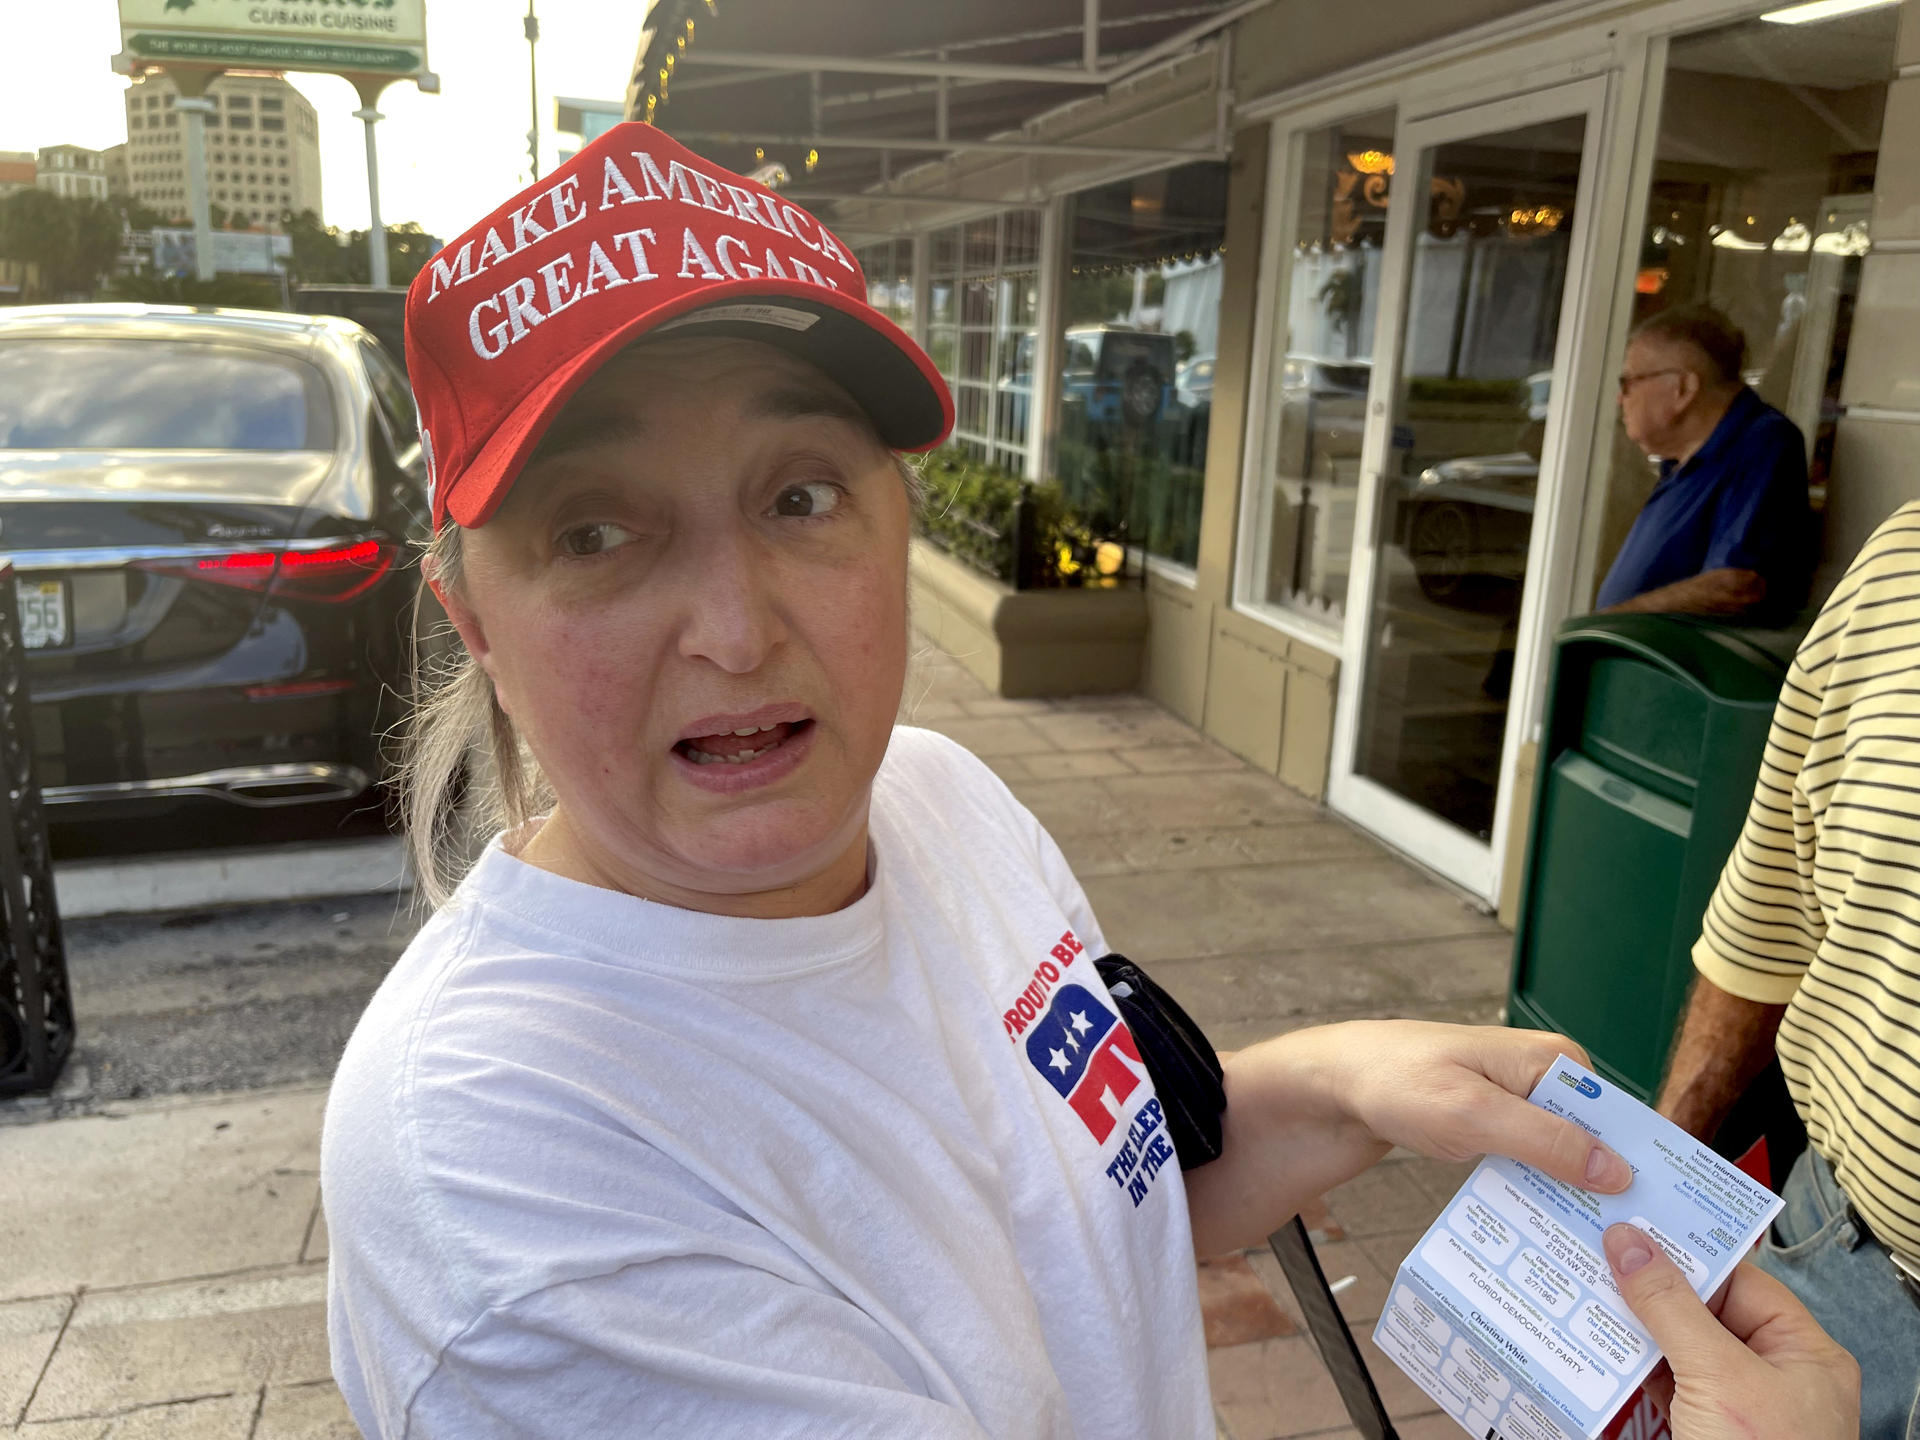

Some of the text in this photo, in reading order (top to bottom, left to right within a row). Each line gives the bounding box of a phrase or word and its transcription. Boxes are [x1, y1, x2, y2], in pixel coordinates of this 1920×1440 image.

[249, 8, 398, 32] CUBAN CUISINE
[428, 152, 854, 304] MAKE AMERICA
[469, 228, 659, 360] GREAT
[1050, 930, 1084, 968] BE
[1546, 1098, 1563, 1112] Ania
[1567, 1111, 1601, 1137] Fresquet
[1105, 1139, 1139, 1189] THE
[1127, 1133, 1174, 1209] IN THE
[1652, 1139, 1759, 1216] Tarjeta de Información del Elector
[1663, 1157, 1693, 1179] Condado
[1692, 1177, 1703, 1187] de
[1689, 1155, 1730, 1185] Miami-Dade
[1694, 1149, 1770, 1203] Voter Information Card
[1556, 1179, 1570, 1191] con
[1681, 1180, 1694, 1191] Kat
[1475, 1205, 1507, 1233] Precinct No.
[1503, 1185, 1521, 1200] Voting
[1521, 1199, 1543, 1218] Location
[1551, 1223, 1570, 1239] Centro
[1448, 1238, 1462, 1251] Party
[1463, 1250, 1487, 1272] Affiliation
[1471, 1230, 1485, 1244] 539
[1528, 1216, 1550, 1235] Citrus
[1550, 1234, 1574, 1255] Grove
[1573, 1253, 1599, 1275] Middle
[1648, 1227, 1682, 1254] Registration
[1681, 1252, 1694, 1263] No.
[1687, 1232, 1718, 1256] 8/23/23
[1521, 1253, 1537, 1267] Fecha
[1536, 1264, 1546, 1274] de
[1536, 1256, 1569, 1285] Date of Birth
[1545, 1241, 1565, 1259] 2153
[1565, 1258, 1579, 1271] NW
[1578, 1269, 1587, 1277] 3
[1585, 1274, 1597, 1286] St
[1408, 1266, 1434, 1292] Supervisor
[1433, 1289, 1442, 1298] of
[1441, 1295, 1464, 1317] Elections
[1524, 1276, 1557, 1305] 2/7/1963
[1468, 1272, 1502, 1303] FLORIDA
[1502, 1301, 1555, 1350] DEMOCRATIC
[1555, 1348, 1583, 1374] PARTY
[1470, 1310, 1504, 1343] Christina
[1504, 1341, 1529, 1365] White
[1585, 1307, 1640, 1354] Fecha de Inscripción
[1586, 1316, 1598, 1328] Dat
[1593, 1304, 1640, 1344] Registration Date
[1588, 1330, 1625, 1363] 10/2/1992
